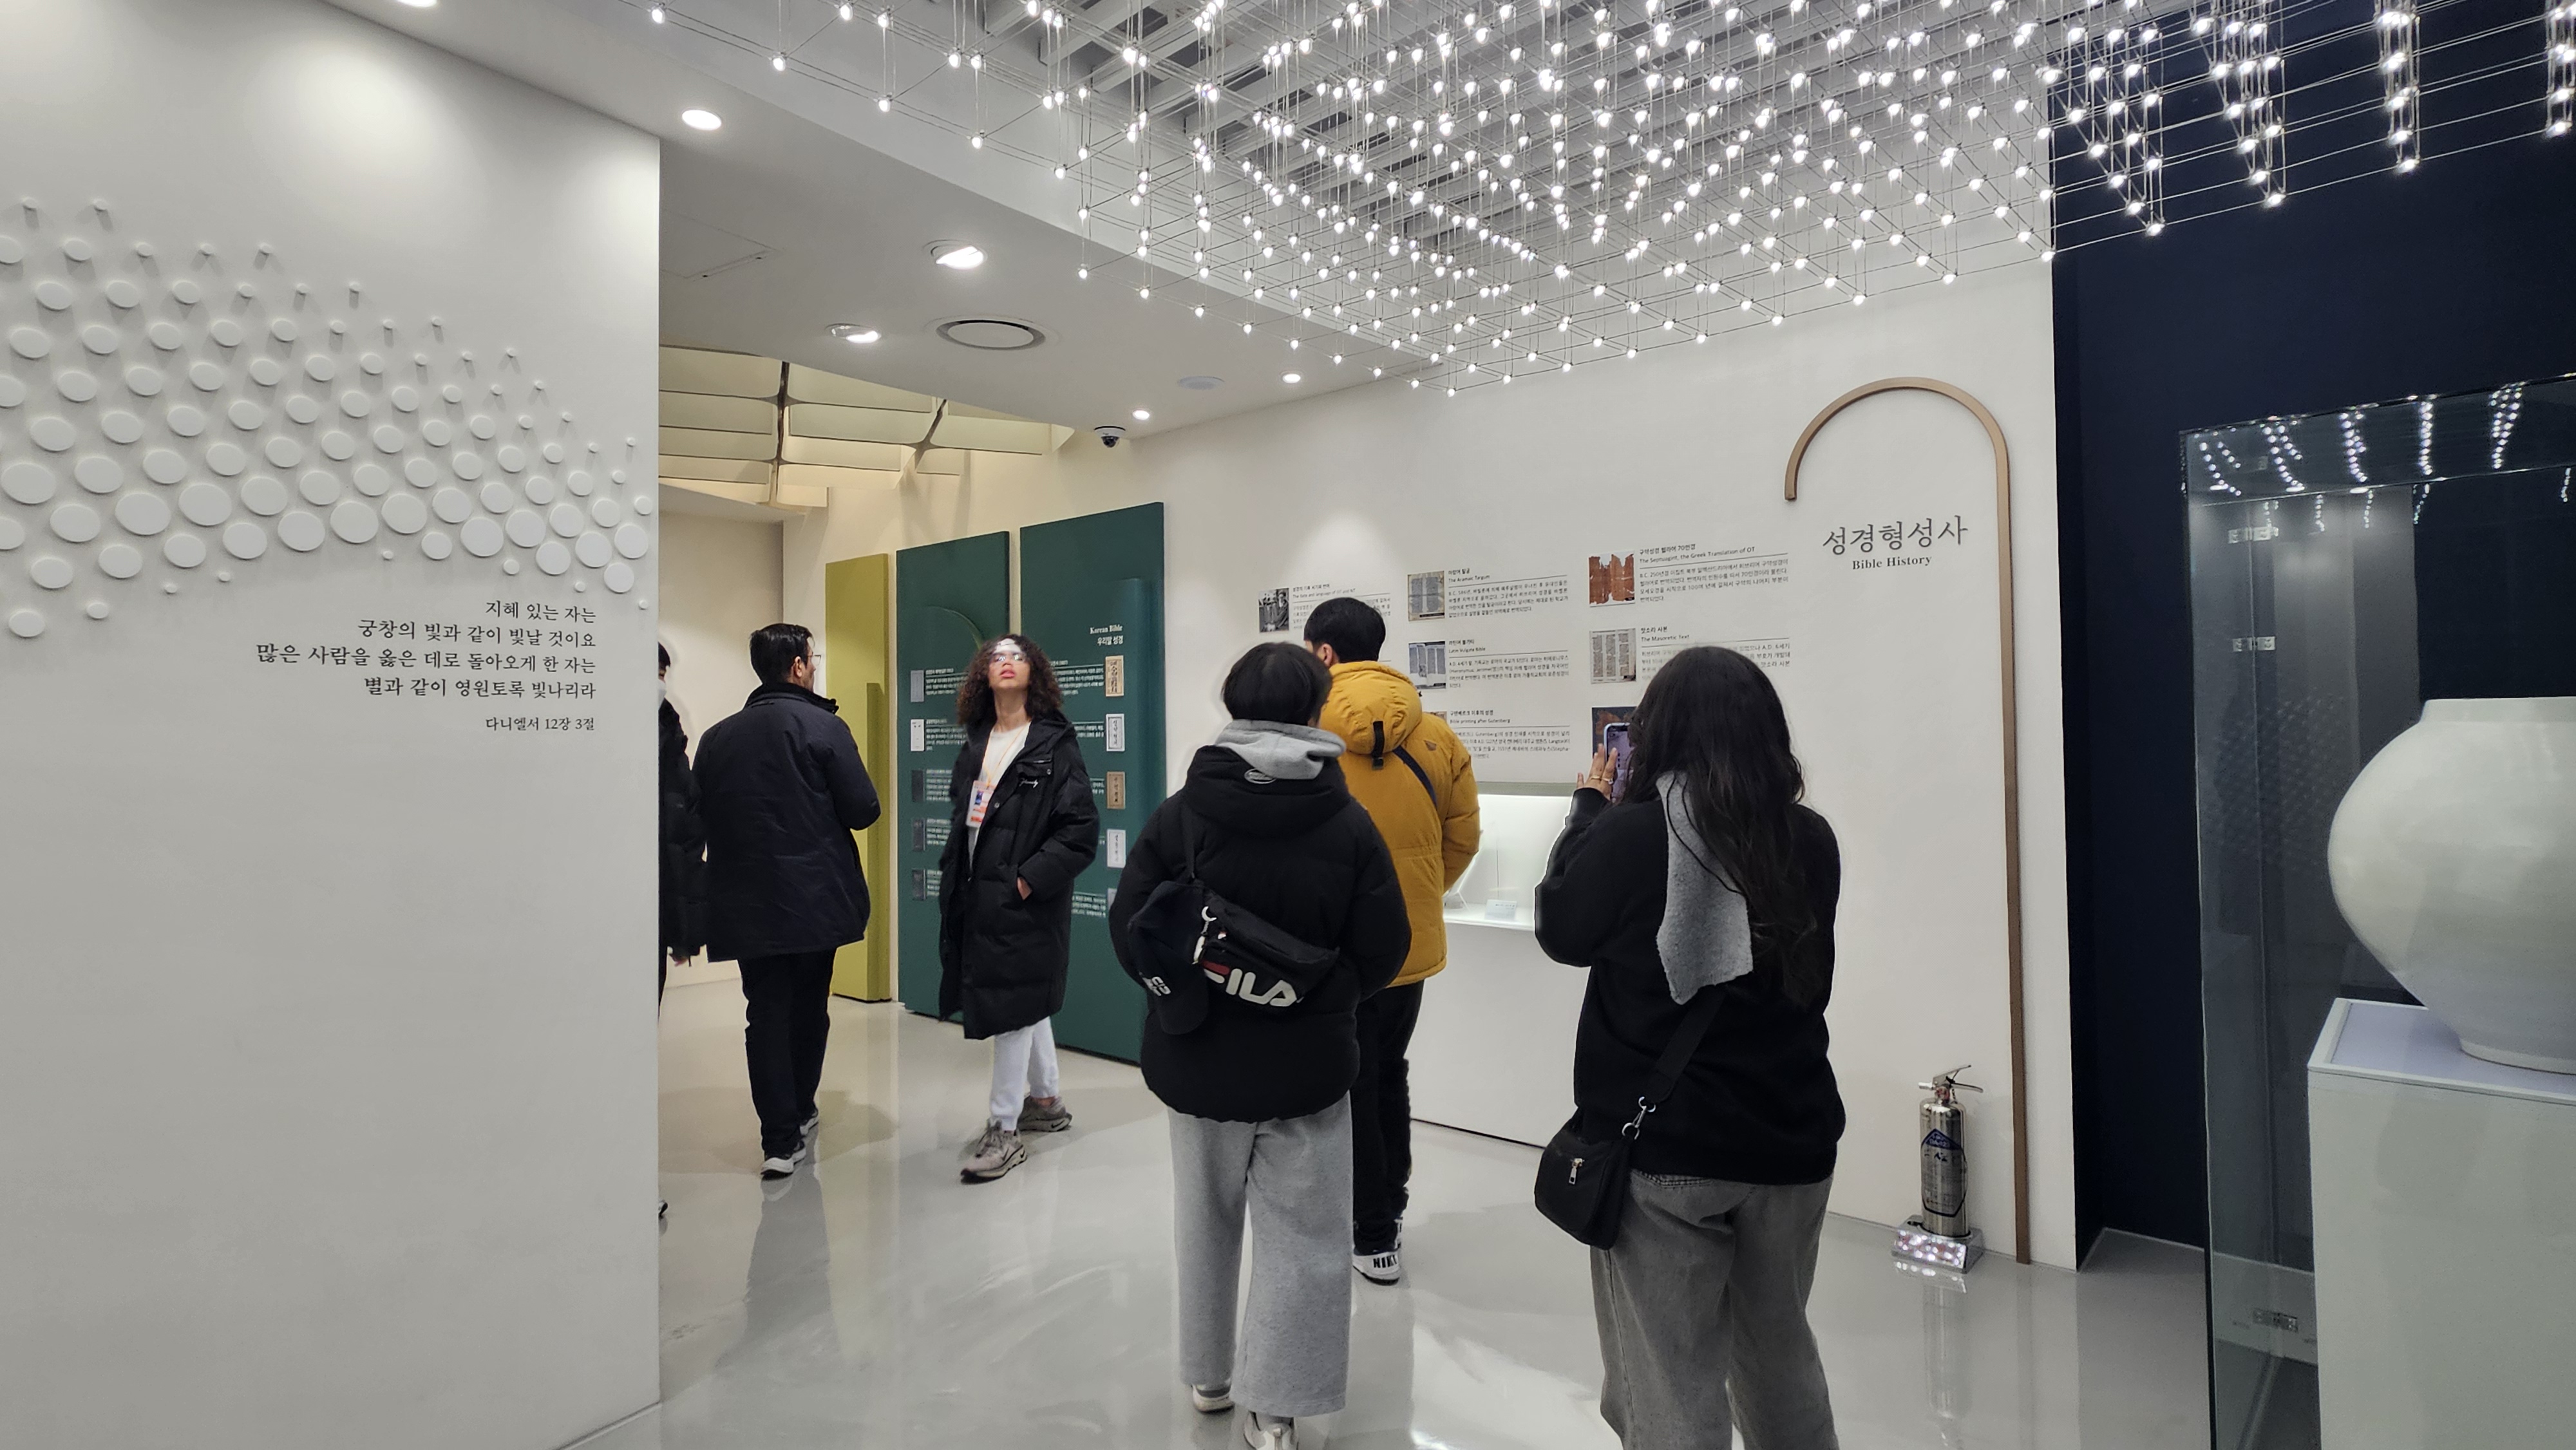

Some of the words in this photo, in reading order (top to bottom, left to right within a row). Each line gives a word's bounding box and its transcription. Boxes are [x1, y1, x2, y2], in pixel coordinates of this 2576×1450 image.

[1823, 515, 1968, 555] 성경형성사
[1853, 559, 1882, 570] Bible
[1887, 556, 1932, 567] History
[486, 601, 519, 619] 지혜
[527, 603, 559, 621] 있는
[564, 606, 596, 623] 자는
[358, 619, 415, 639] 궁창의
[425, 623, 461, 643] 빛과
[468, 626, 501, 644] 같이
[509, 628, 542, 646] 빛날
[548, 630, 596, 648] 것이요
[256, 644, 301, 663] 많은
[308, 646, 370, 666] 사람을
[378, 648, 417, 668] 옳은
[424, 650, 460, 669] 데로
[468, 652, 536, 672] 돌아오게
[544, 655, 558, 672] 한
[564, 656, 596, 674] 자는
[365, 677, 403, 696] 별과
[410, 679, 446, 697] 같이
[455, 679, 525, 698] 영원토록
[533, 682, 596, 700] 빛나리라
[486, 717, 540, 731] 다니엘서
[545, 717, 571, 731] 12장
[576, 718, 594, 732] 3절
